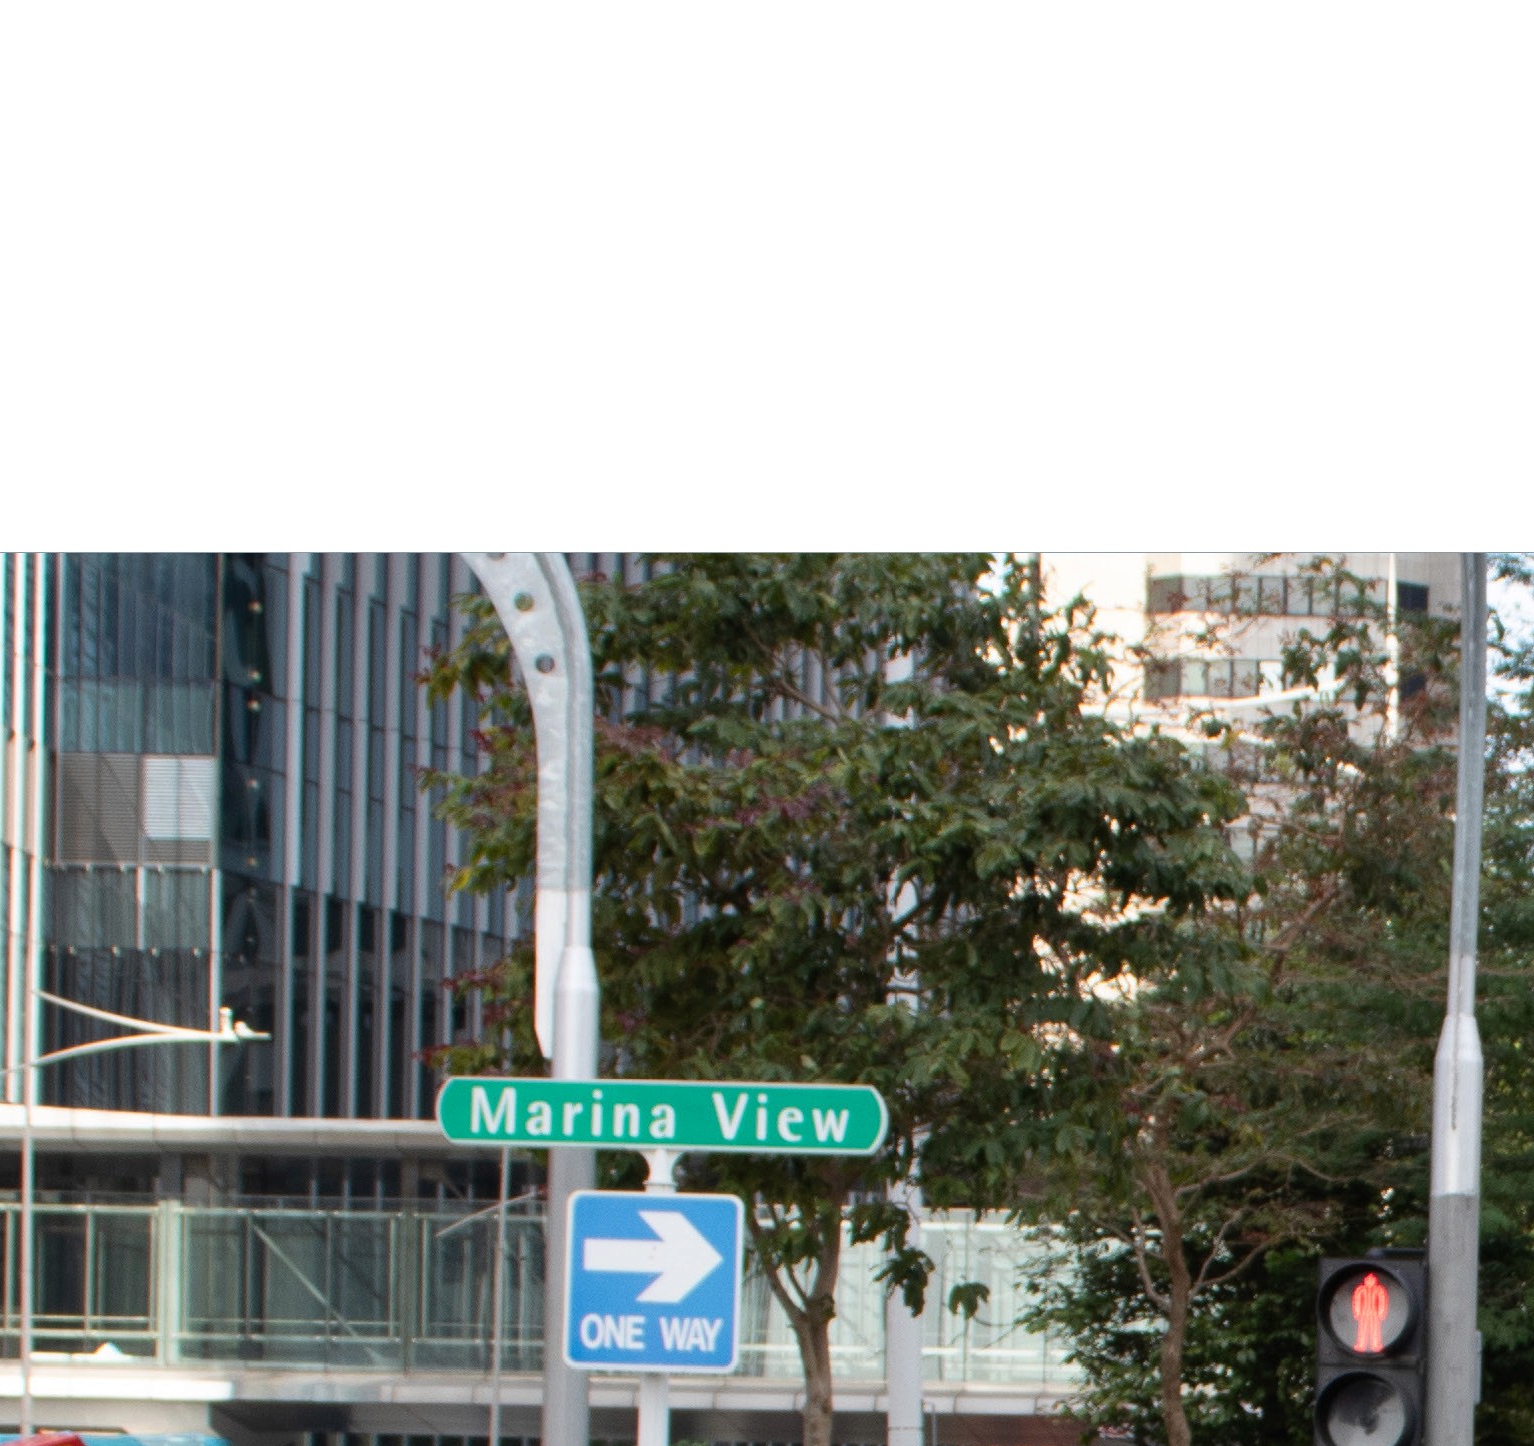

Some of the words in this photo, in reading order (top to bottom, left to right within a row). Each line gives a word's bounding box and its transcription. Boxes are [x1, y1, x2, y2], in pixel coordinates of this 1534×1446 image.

[469, 1087, 676, 1139] Marina
[712, 1092, 851, 1143] View
[579, 1313, 645, 1350] ONE
[659, 1316, 723, 1352] WAY
